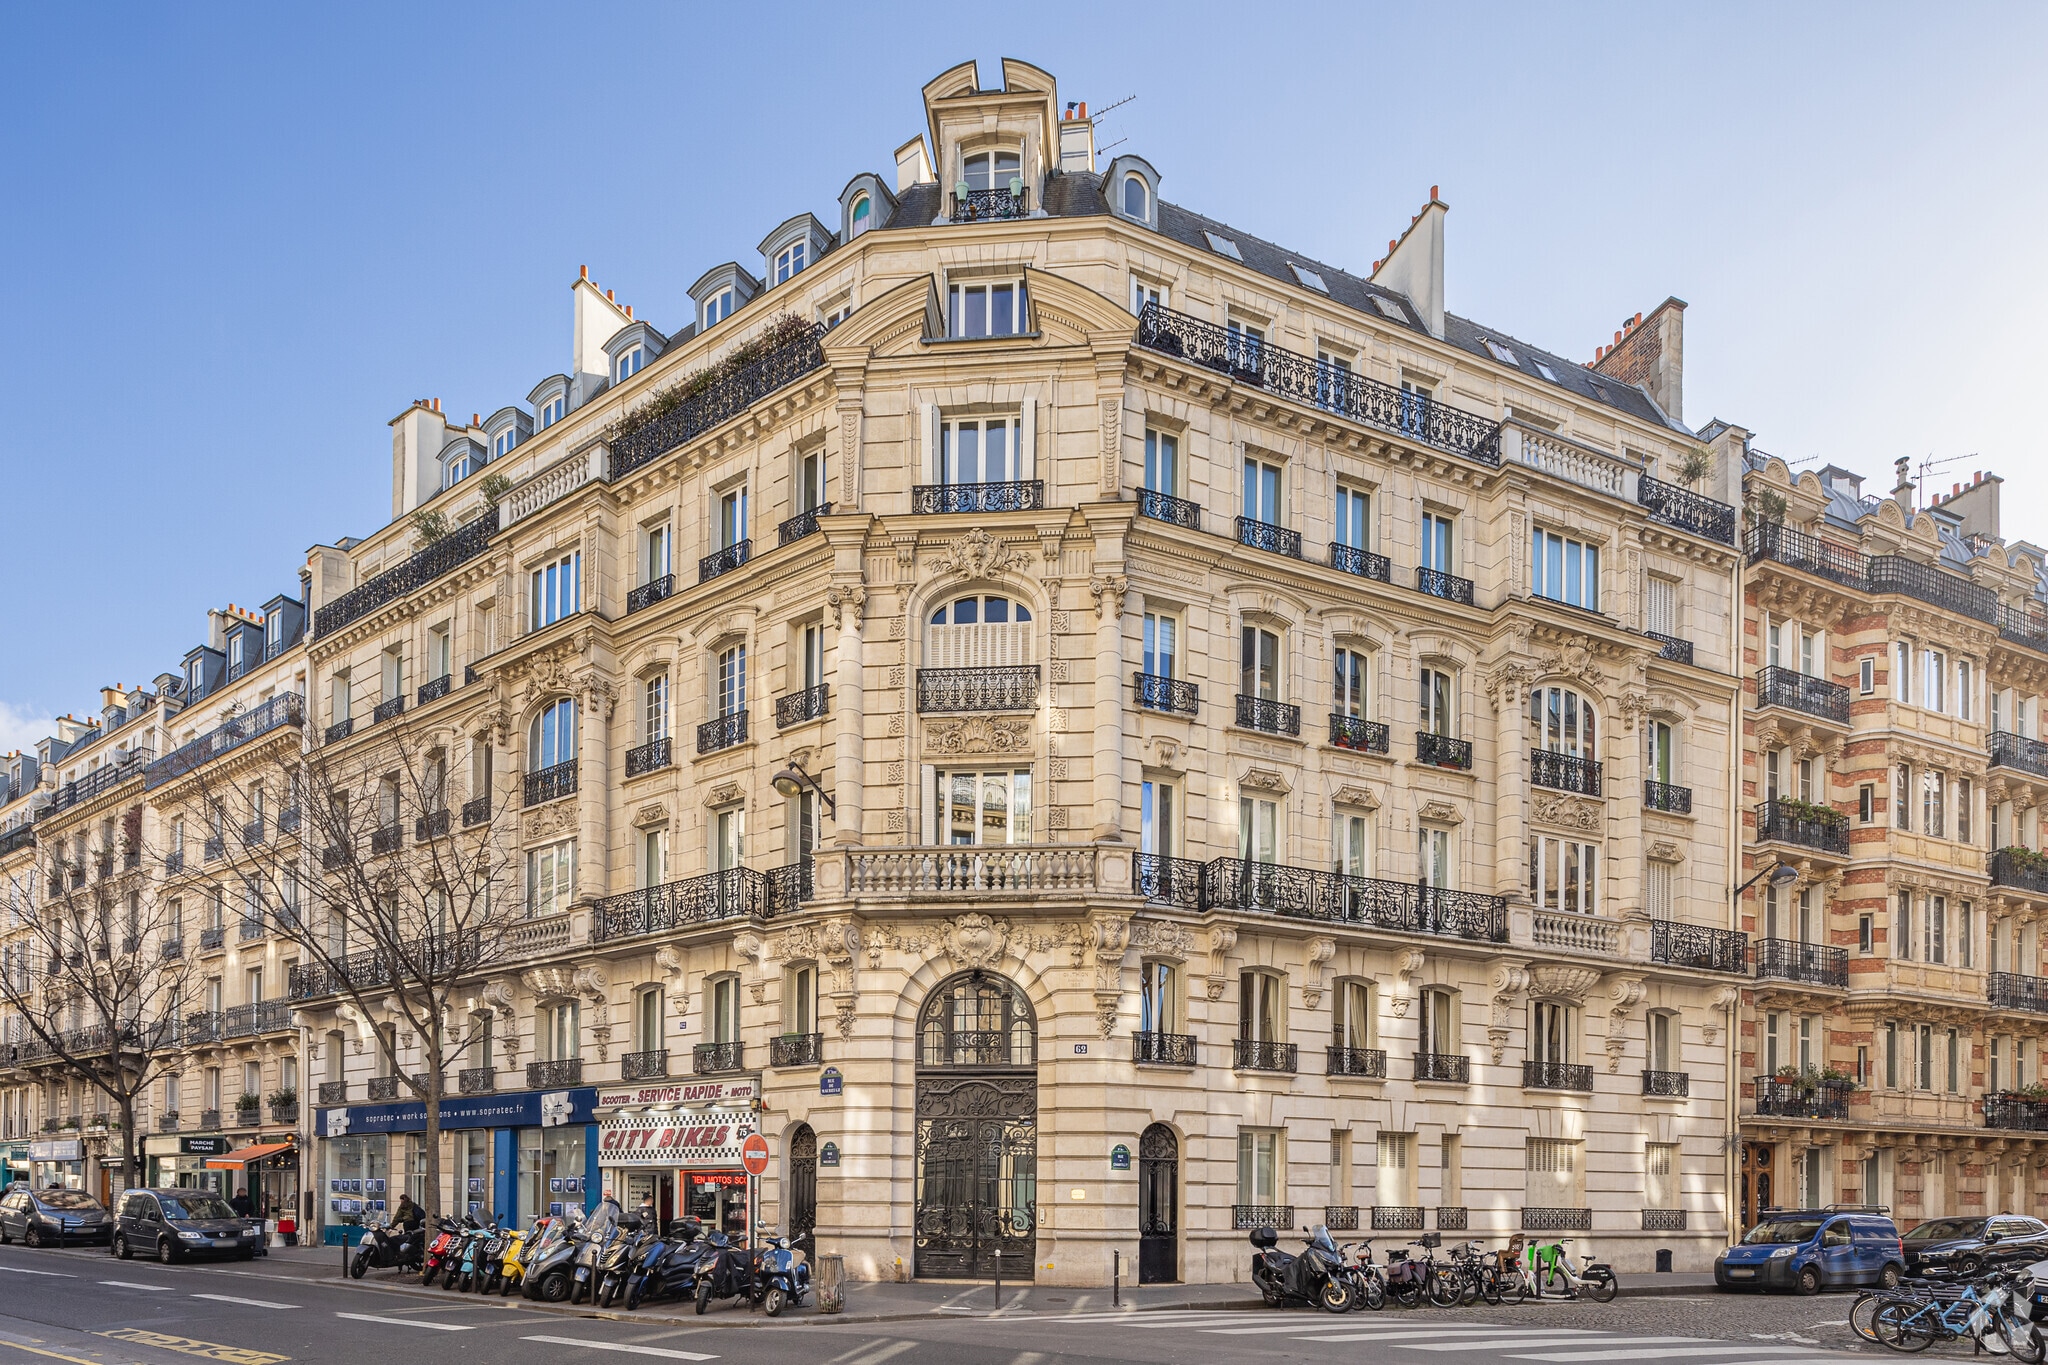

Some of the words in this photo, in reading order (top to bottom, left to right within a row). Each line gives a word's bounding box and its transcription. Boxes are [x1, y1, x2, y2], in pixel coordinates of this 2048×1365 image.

[1075, 1045, 1086, 1053] 62
[601, 1095, 630, 1105] SCOOTER
[637, 1087, 681, 1103] SERVICE
[683, 1084, 723, 1100] RAPIDE
[730, 1086, 752, 1097] MOTO
[366, 1115, 394, 1123] sopratec
[402, 1112, 418, 1120] work
[419, 1110, 451, 1119] soons
[460, 1104, 523, 1117] www.sopratec.fr
[603, 1128, 657, 1150] CITY
[658, 1125, 731, 1148] BIKES
[739, 1128, 748, 1136] 75
[707, 1175, 732, 1184] MOTOS
